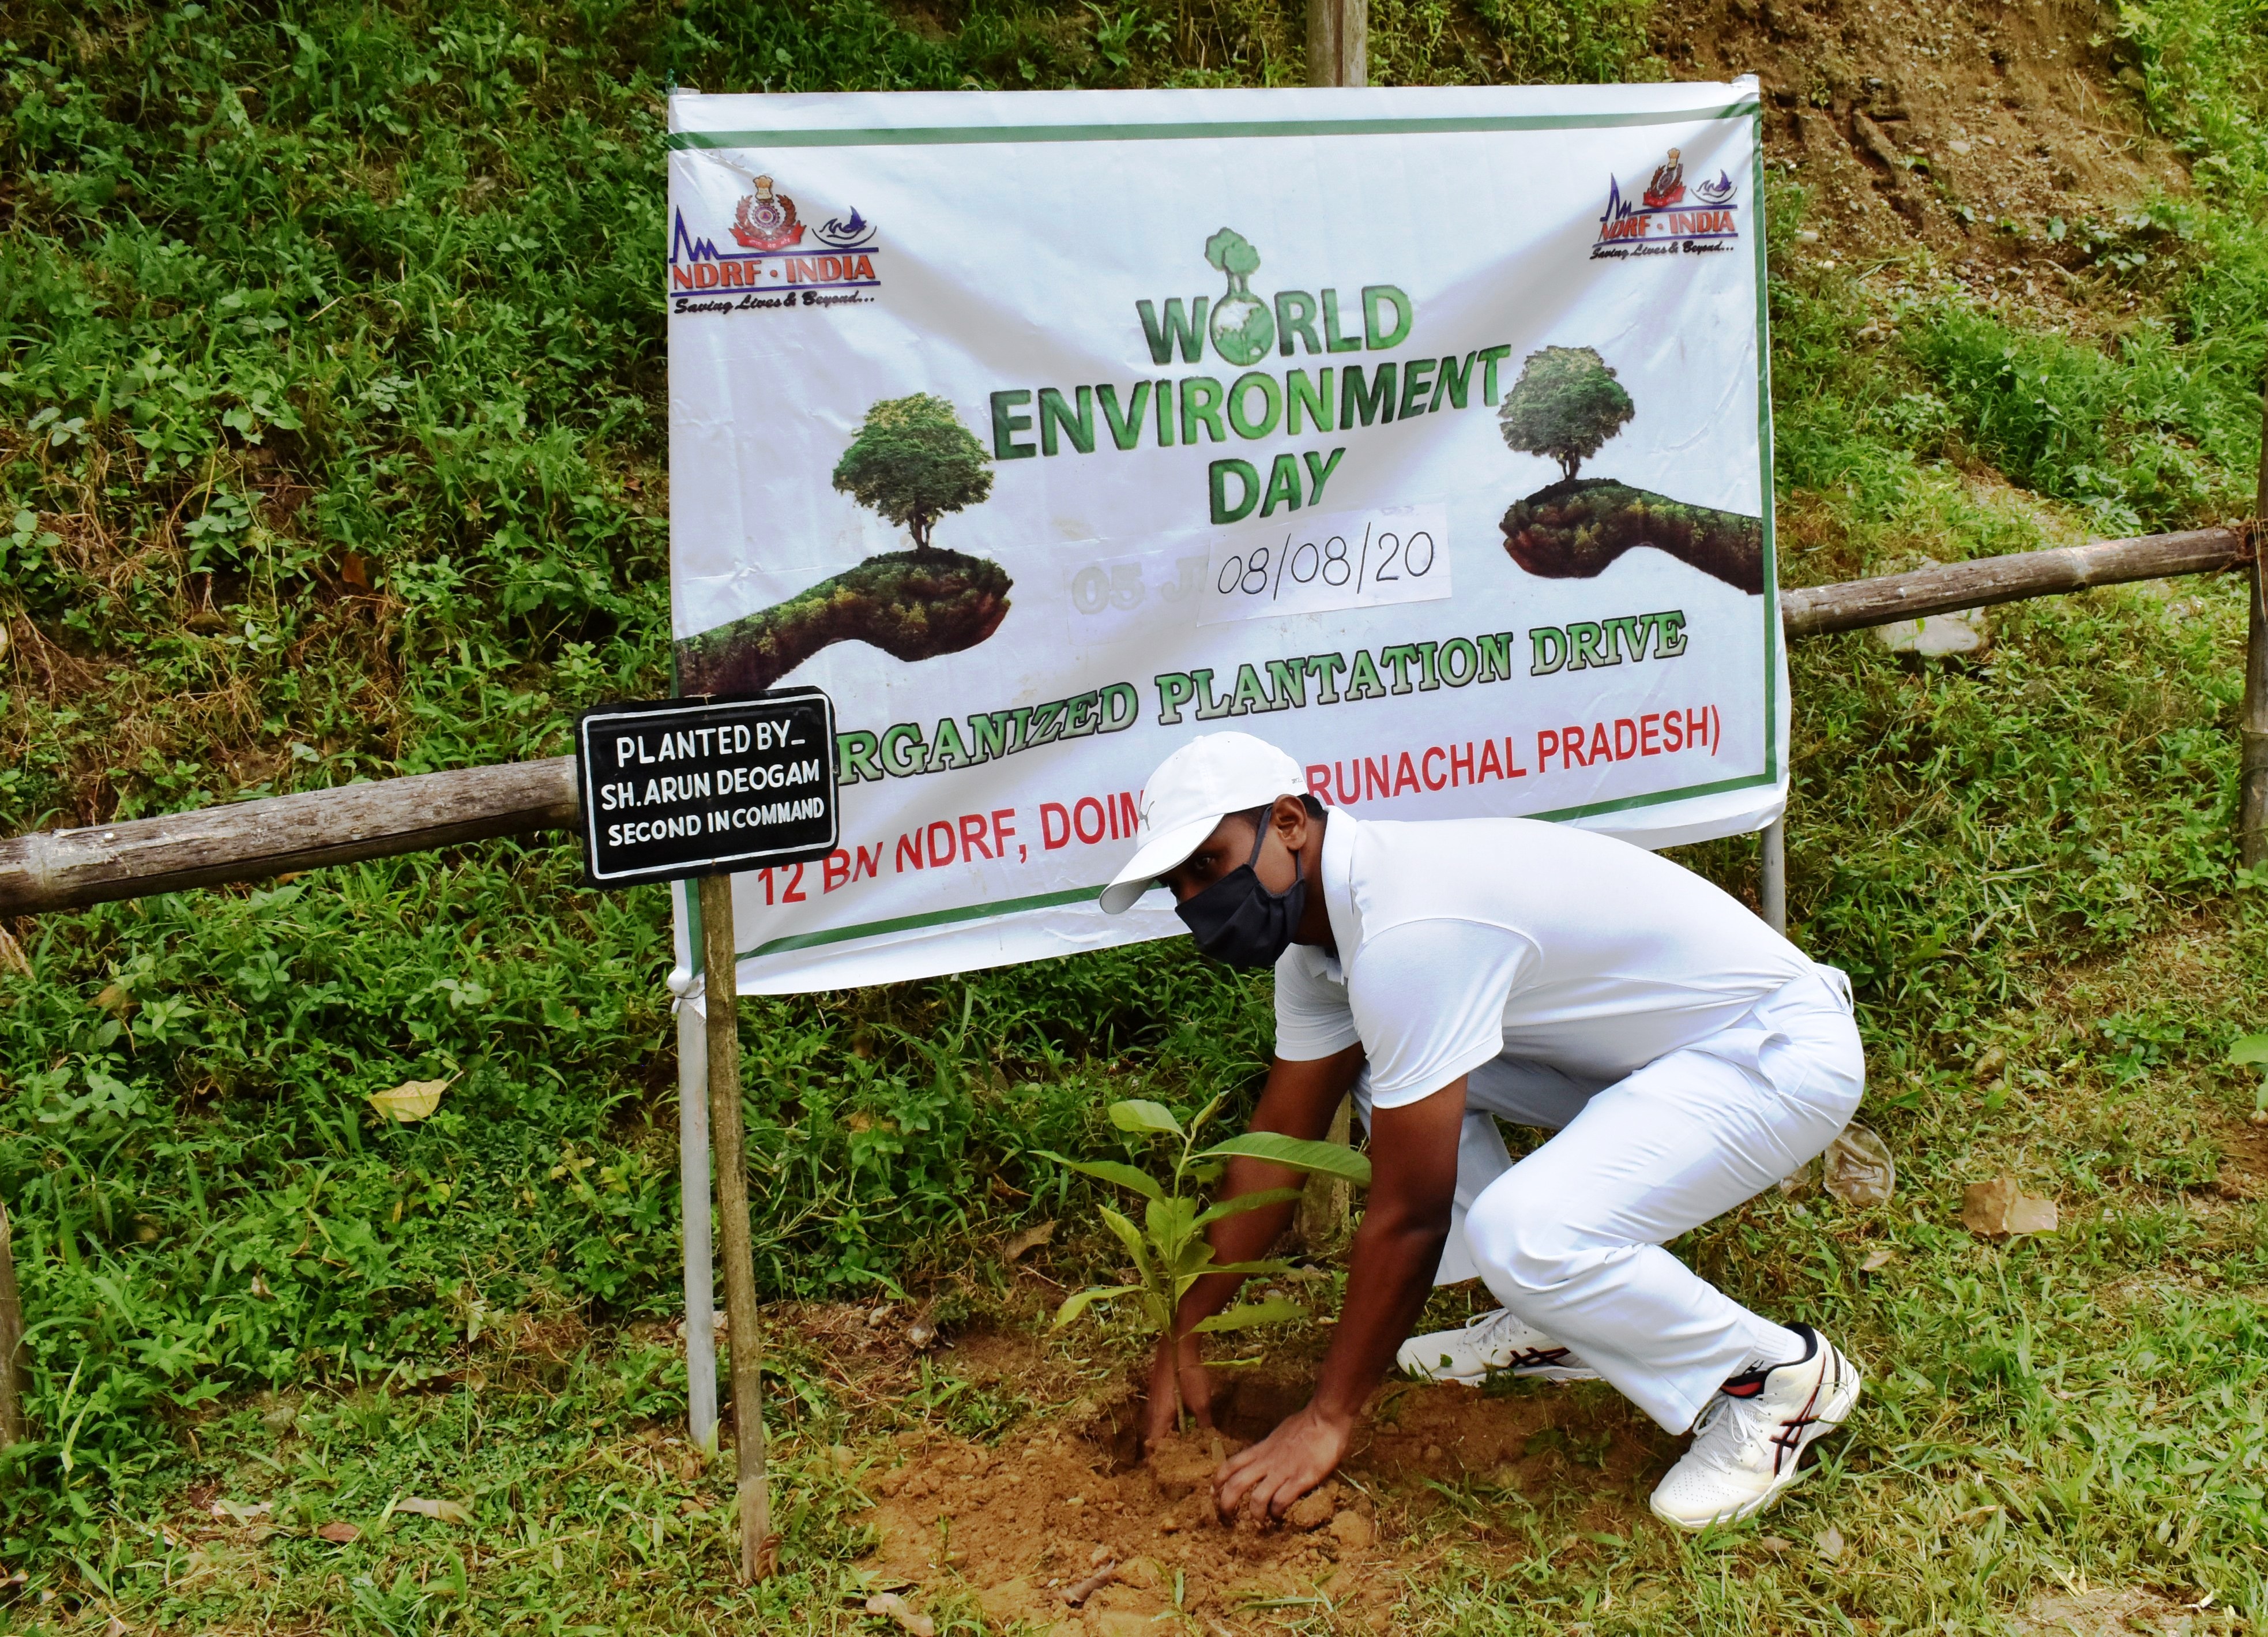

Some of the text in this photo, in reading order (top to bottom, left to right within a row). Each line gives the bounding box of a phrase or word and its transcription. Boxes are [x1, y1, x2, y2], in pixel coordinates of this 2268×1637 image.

[1598, 211, 1735, 242] NDRF INDIA
[673, 255, 875, 290] NDRF INDIA
[1590, 247, 1629, 260] Saving
[1630, 243, 1667, 256] Lives
[674, 298, 734, 314] Saving
[735, 294, 782, 309] Lives
[783, 292, 796, 307] &
[1135, 285, 1413, 366] WORLD
[990, 344, 1511, 460] ENVIRONMENT
[1209, 448, 1345, 524] DAY
[1217, 522, 1434, 600] 08/08/20
[1154, 632, 1513, 726] PLANTATION
[1529, 610, 1688, 676] DRIVE
[616, 724, 751, 768] PLANTED
[717, 759, 820, 795] DEOGAM
[608, 797, 825, 846] SECOND IN COMMAND
[758, 862, 806, 905] 12
[822, 842, 883, 894] BN
[896, 808, 1027, 873] NDRF,
[1537, 705, 1720, 773] PRADESH)
